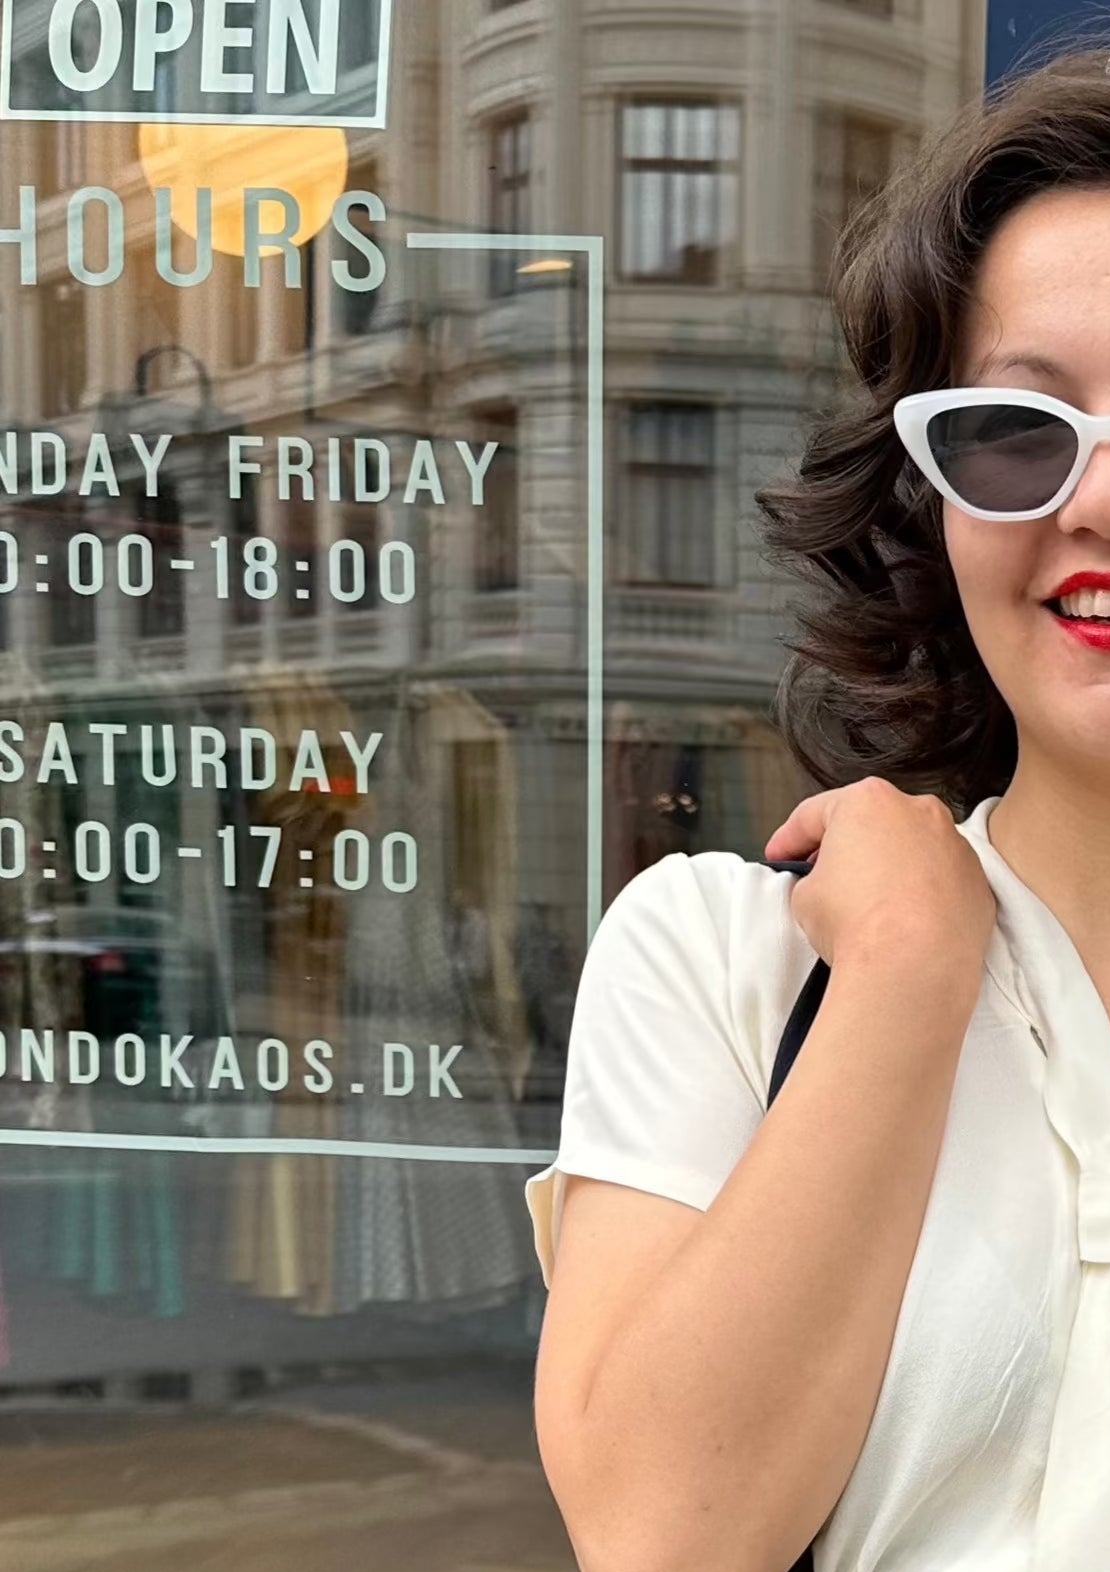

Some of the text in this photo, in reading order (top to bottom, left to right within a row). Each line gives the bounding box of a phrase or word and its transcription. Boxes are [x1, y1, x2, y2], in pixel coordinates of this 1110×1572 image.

[48, 0, 340, 95] OPEN
[0, 184, 387, 292] HOURS
[228, 435, 499, 506] FRIDAY
[0, 720, 383, 794] SATURDAY
[0, 1028, 463, 1098] NDOKAOS.DK
